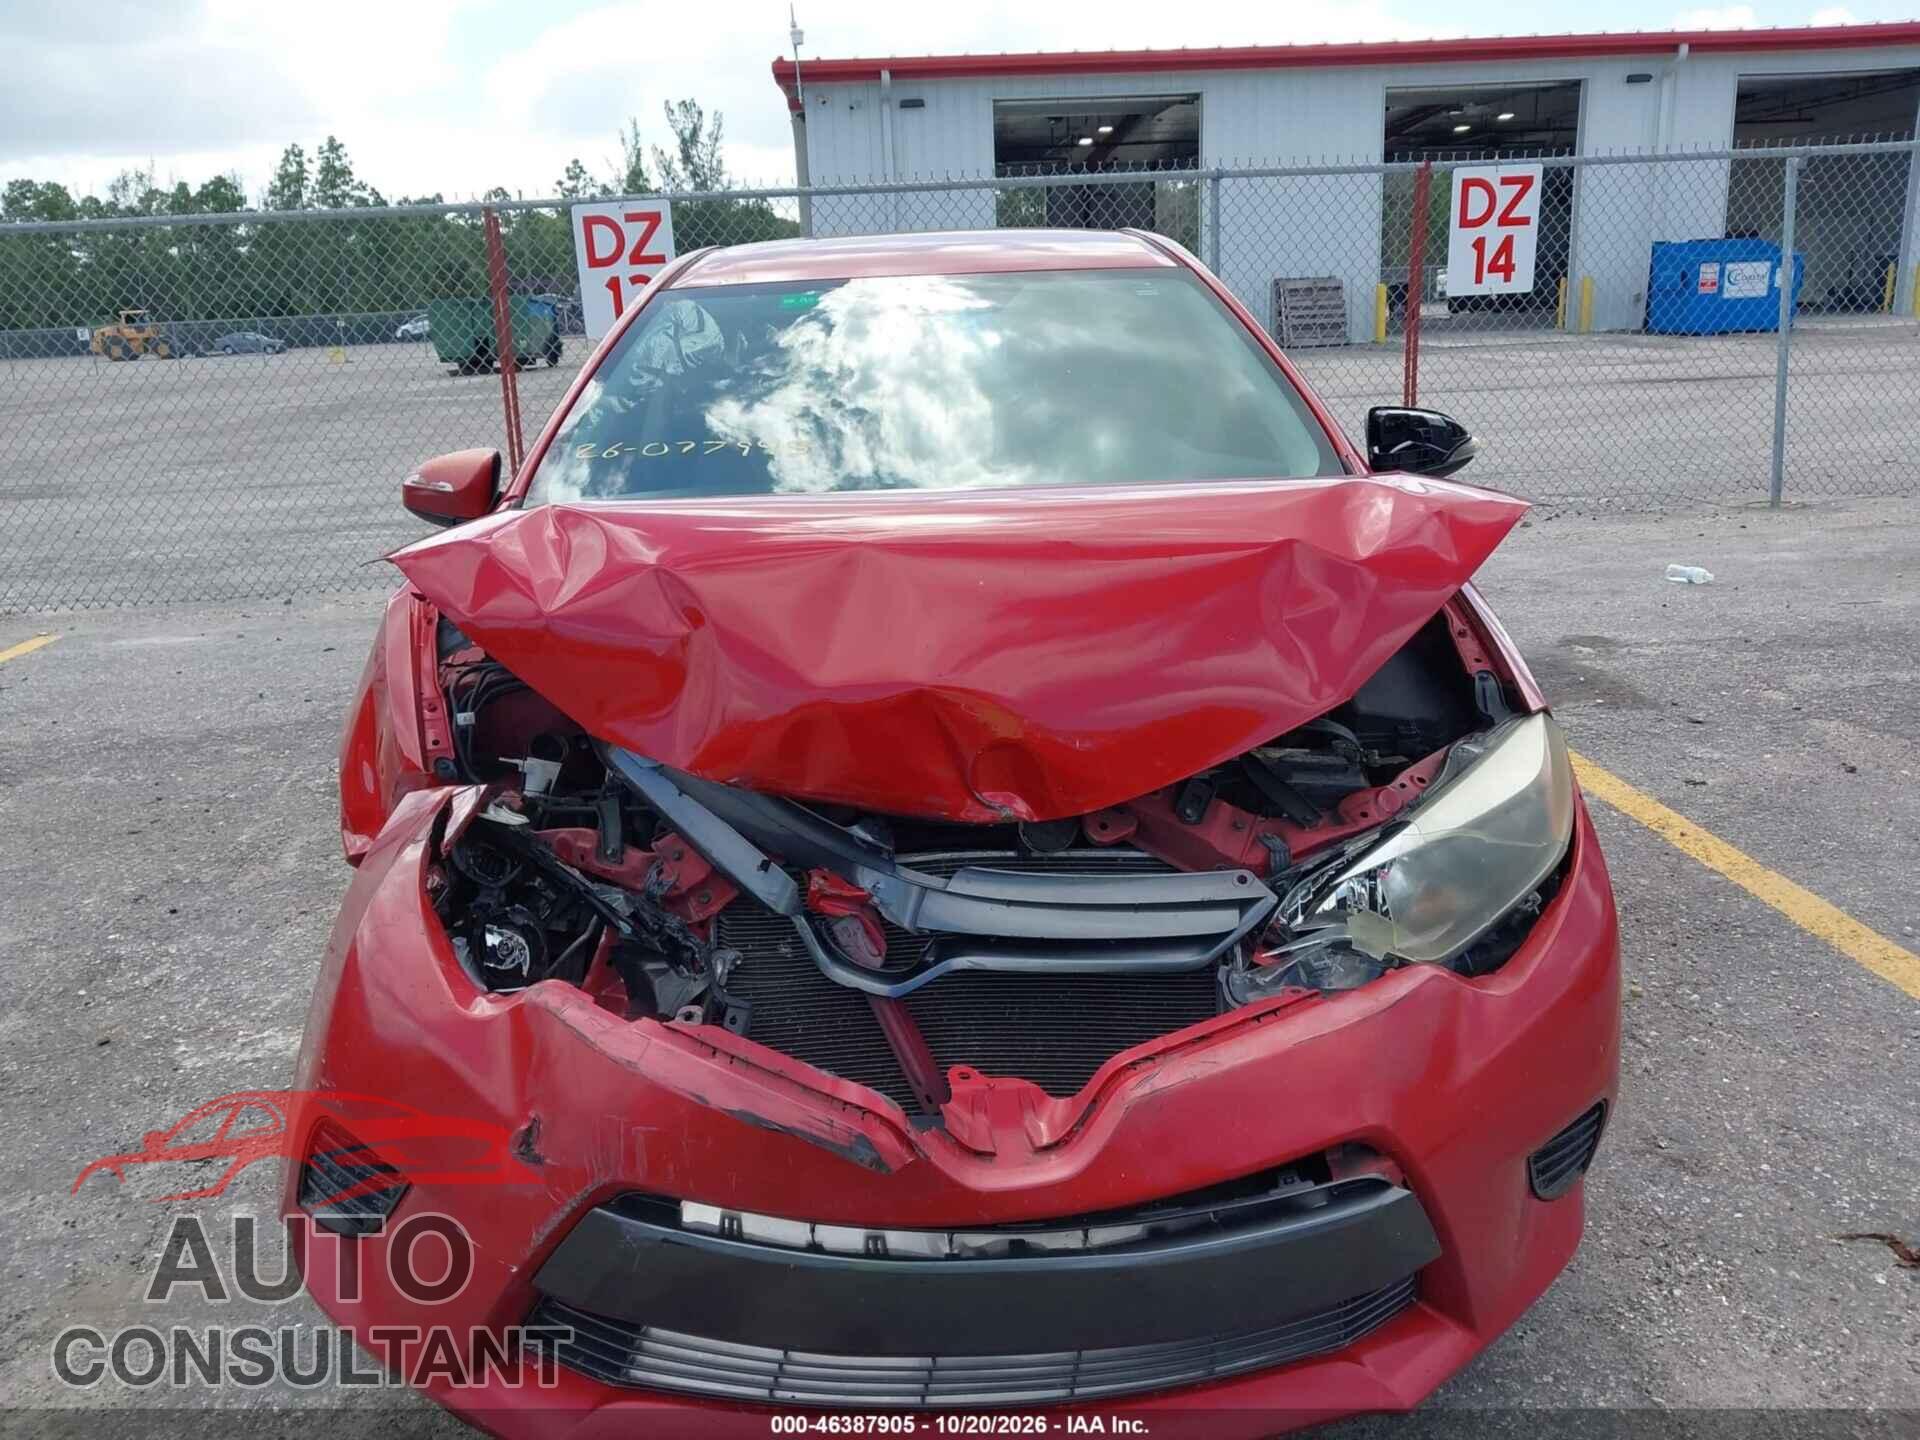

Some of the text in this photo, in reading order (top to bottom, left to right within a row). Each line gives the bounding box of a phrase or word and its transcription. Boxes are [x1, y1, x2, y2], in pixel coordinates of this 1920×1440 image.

[1458, 175, 1535, 229] DZ
[582, 211, 666, 268] DZ
[1472, 234, 1515, 284] 14
[605, 274, 652, 320] 1
